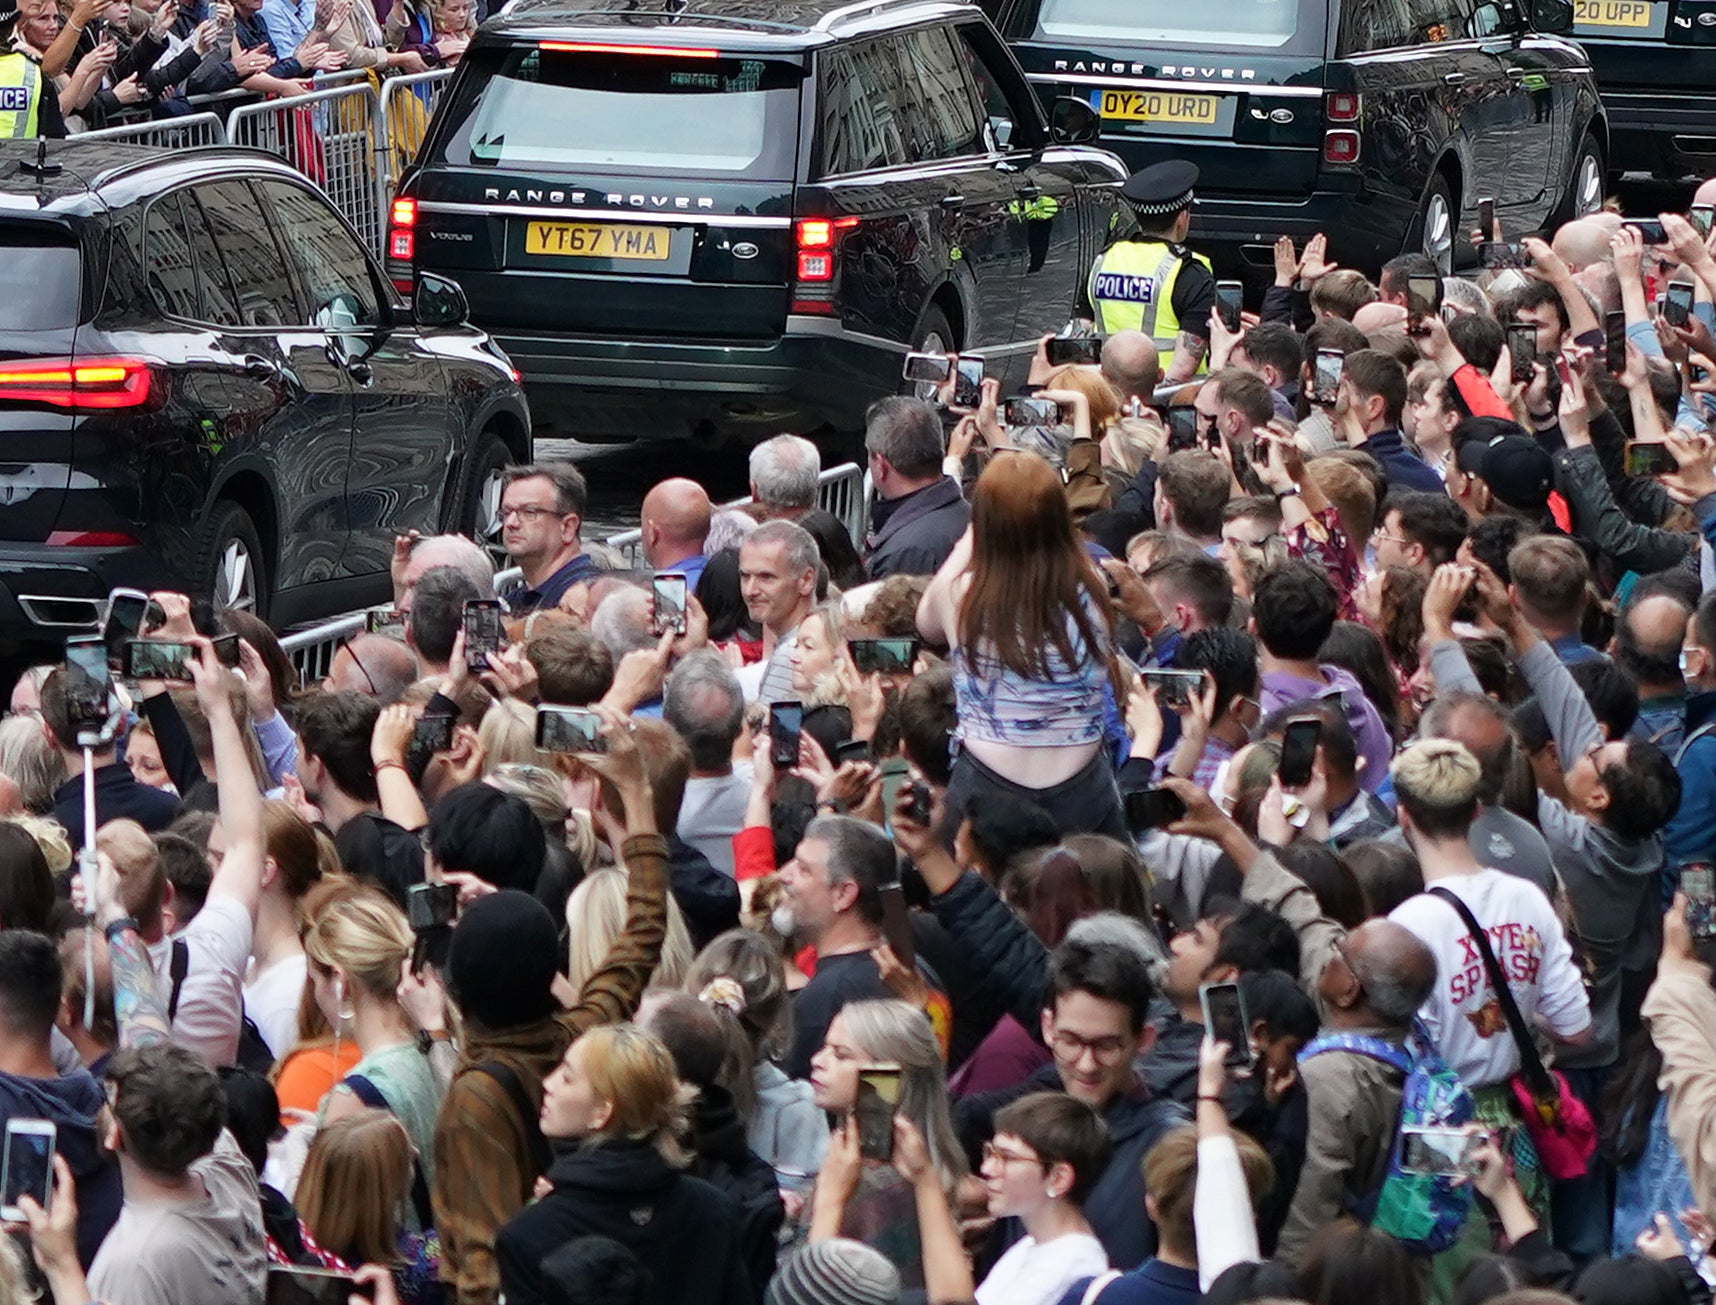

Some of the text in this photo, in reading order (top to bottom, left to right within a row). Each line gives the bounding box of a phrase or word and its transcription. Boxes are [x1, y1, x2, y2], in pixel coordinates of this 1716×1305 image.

[1575, 1, 1645, 22] 20 UPP
[1054, 60, 1256, 80] RANGE ROVER
[1104, 93, 1212, 118] OY20 URD
[485, 188, 714, 210] RANGE ROVER
[539, 225, 657, 255] YT67 YMA
[1095, 276, 1152, 301] POLICE
